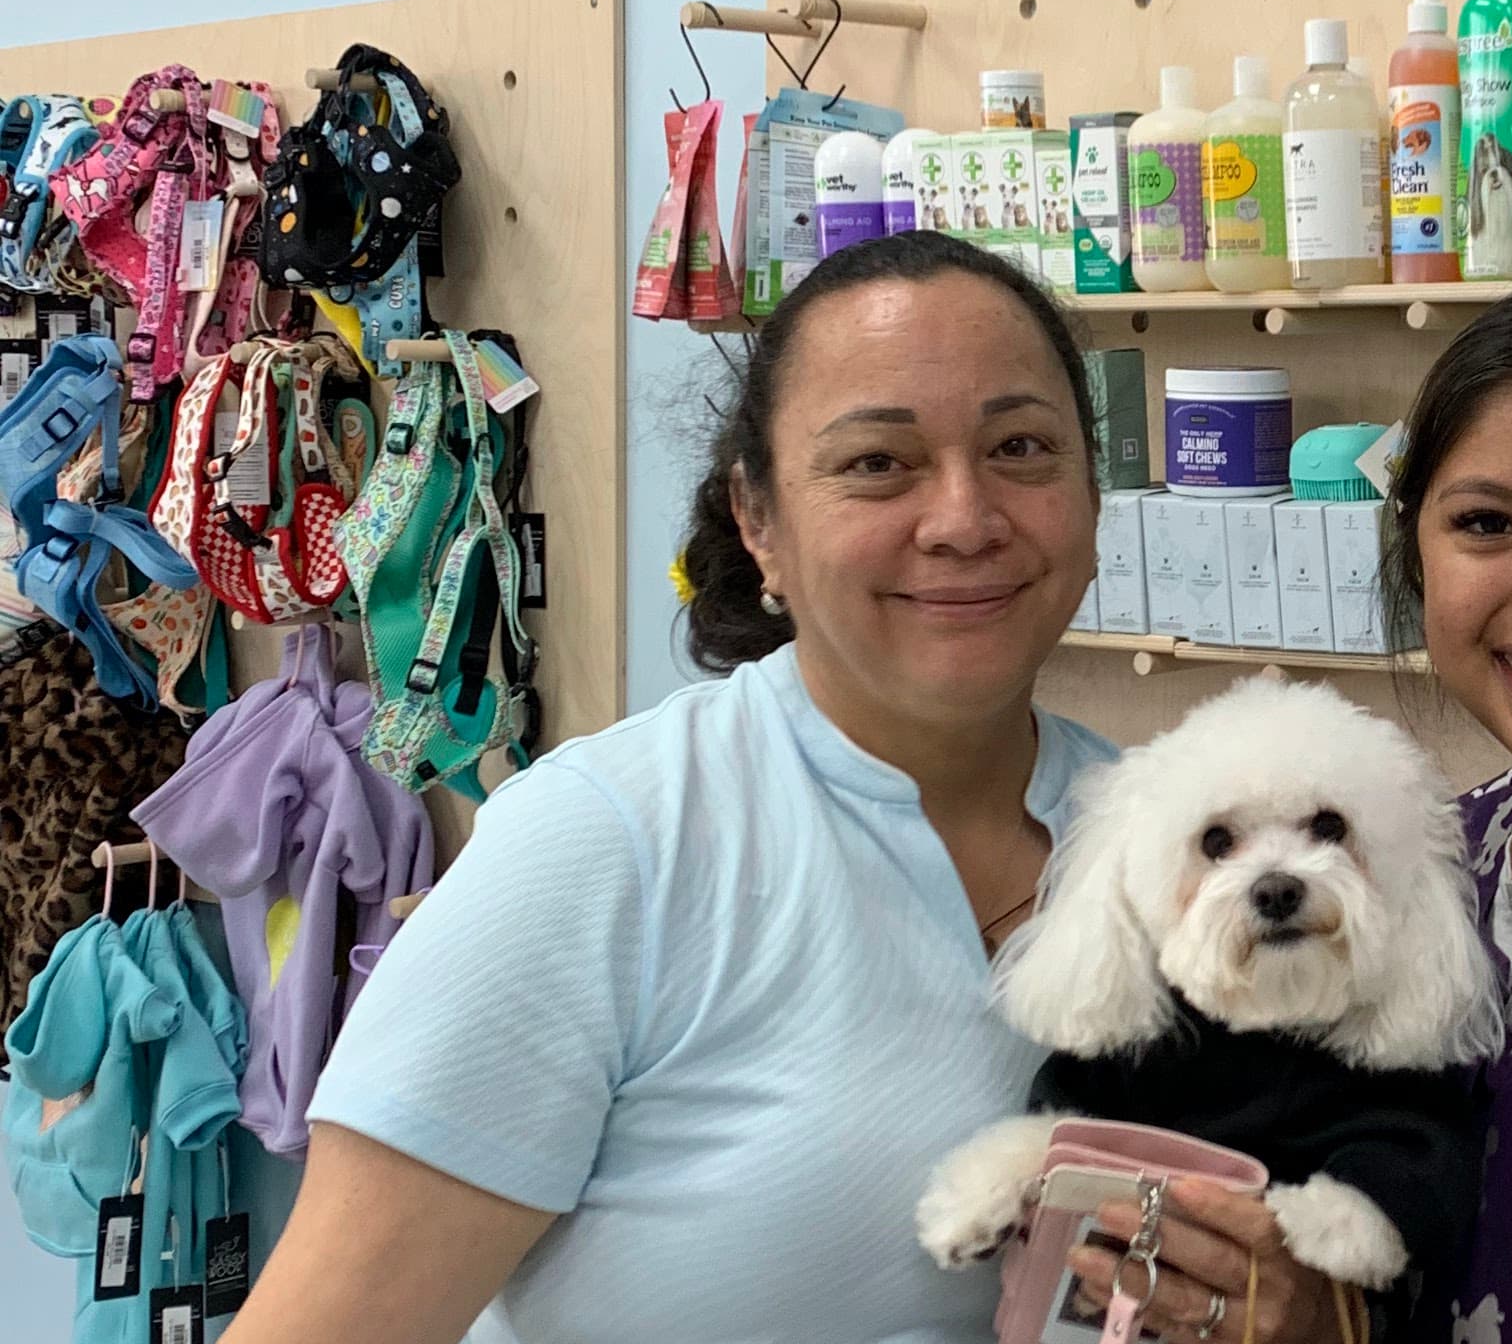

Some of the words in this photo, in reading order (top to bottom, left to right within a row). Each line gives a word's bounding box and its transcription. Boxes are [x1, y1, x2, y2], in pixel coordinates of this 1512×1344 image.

[1477, 78, 1512, 94] Show
[1391, 161, 1426, 179] Fresh
[1391, 179, 1429, 196] Clean
[1176, 450, 1195, 464] SOFT
[1195, 451, 1228, 465] CHEWS
